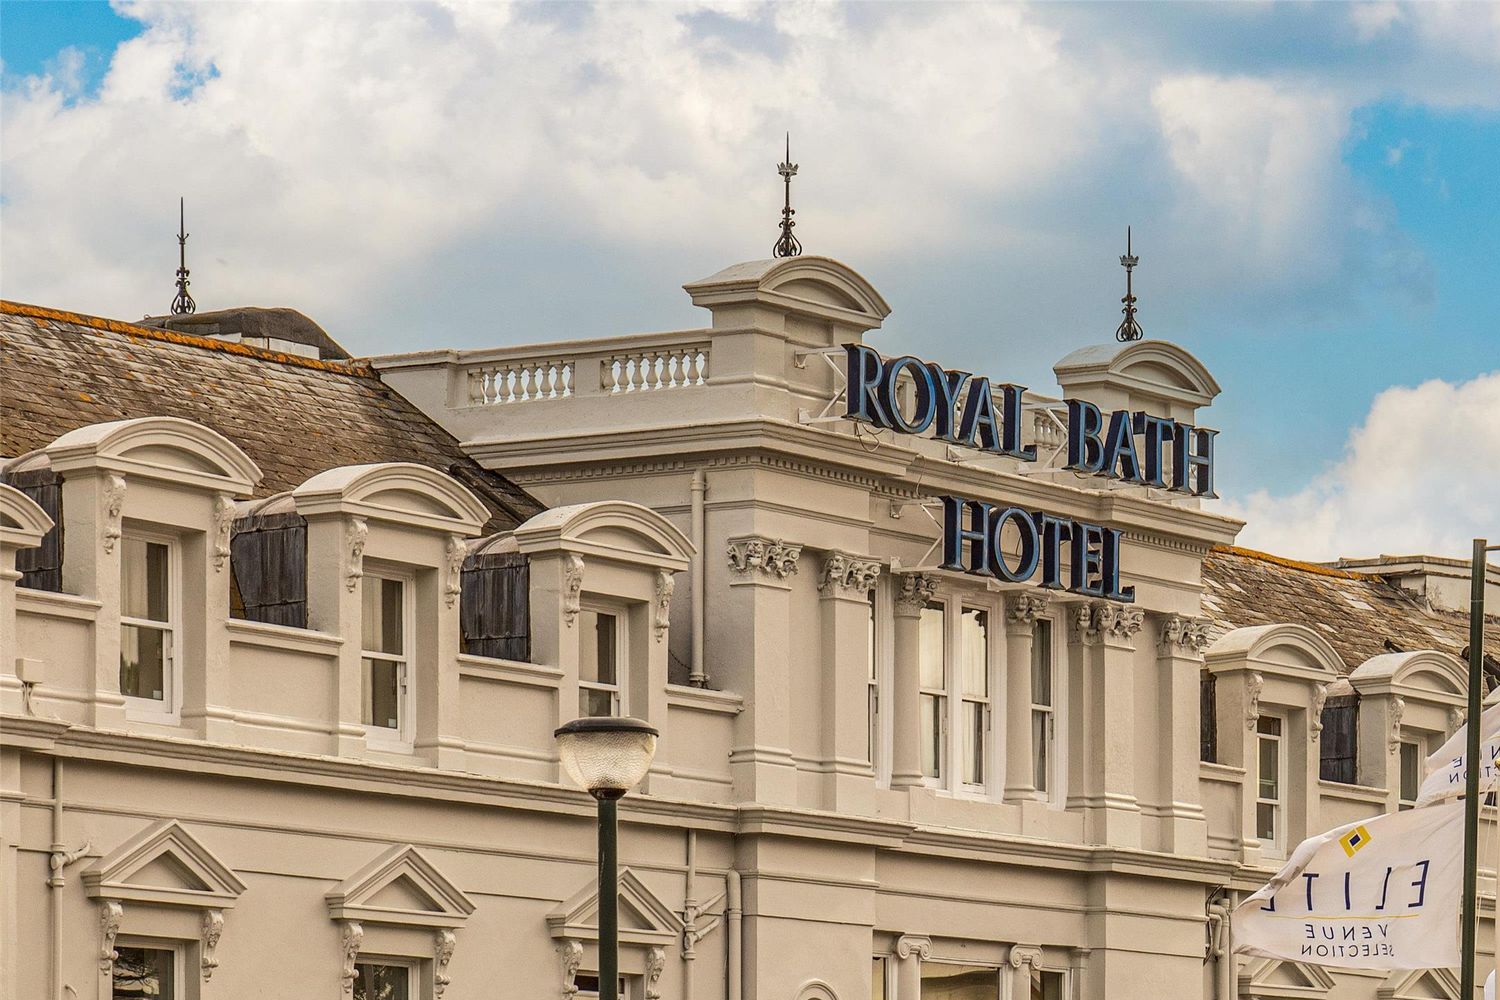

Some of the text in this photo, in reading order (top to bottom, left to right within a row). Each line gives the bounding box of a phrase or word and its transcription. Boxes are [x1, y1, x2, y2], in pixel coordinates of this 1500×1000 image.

[841, 343, 1220, 499] ROYAL BATH
[938, 495, 1135, 602] HOTEL
